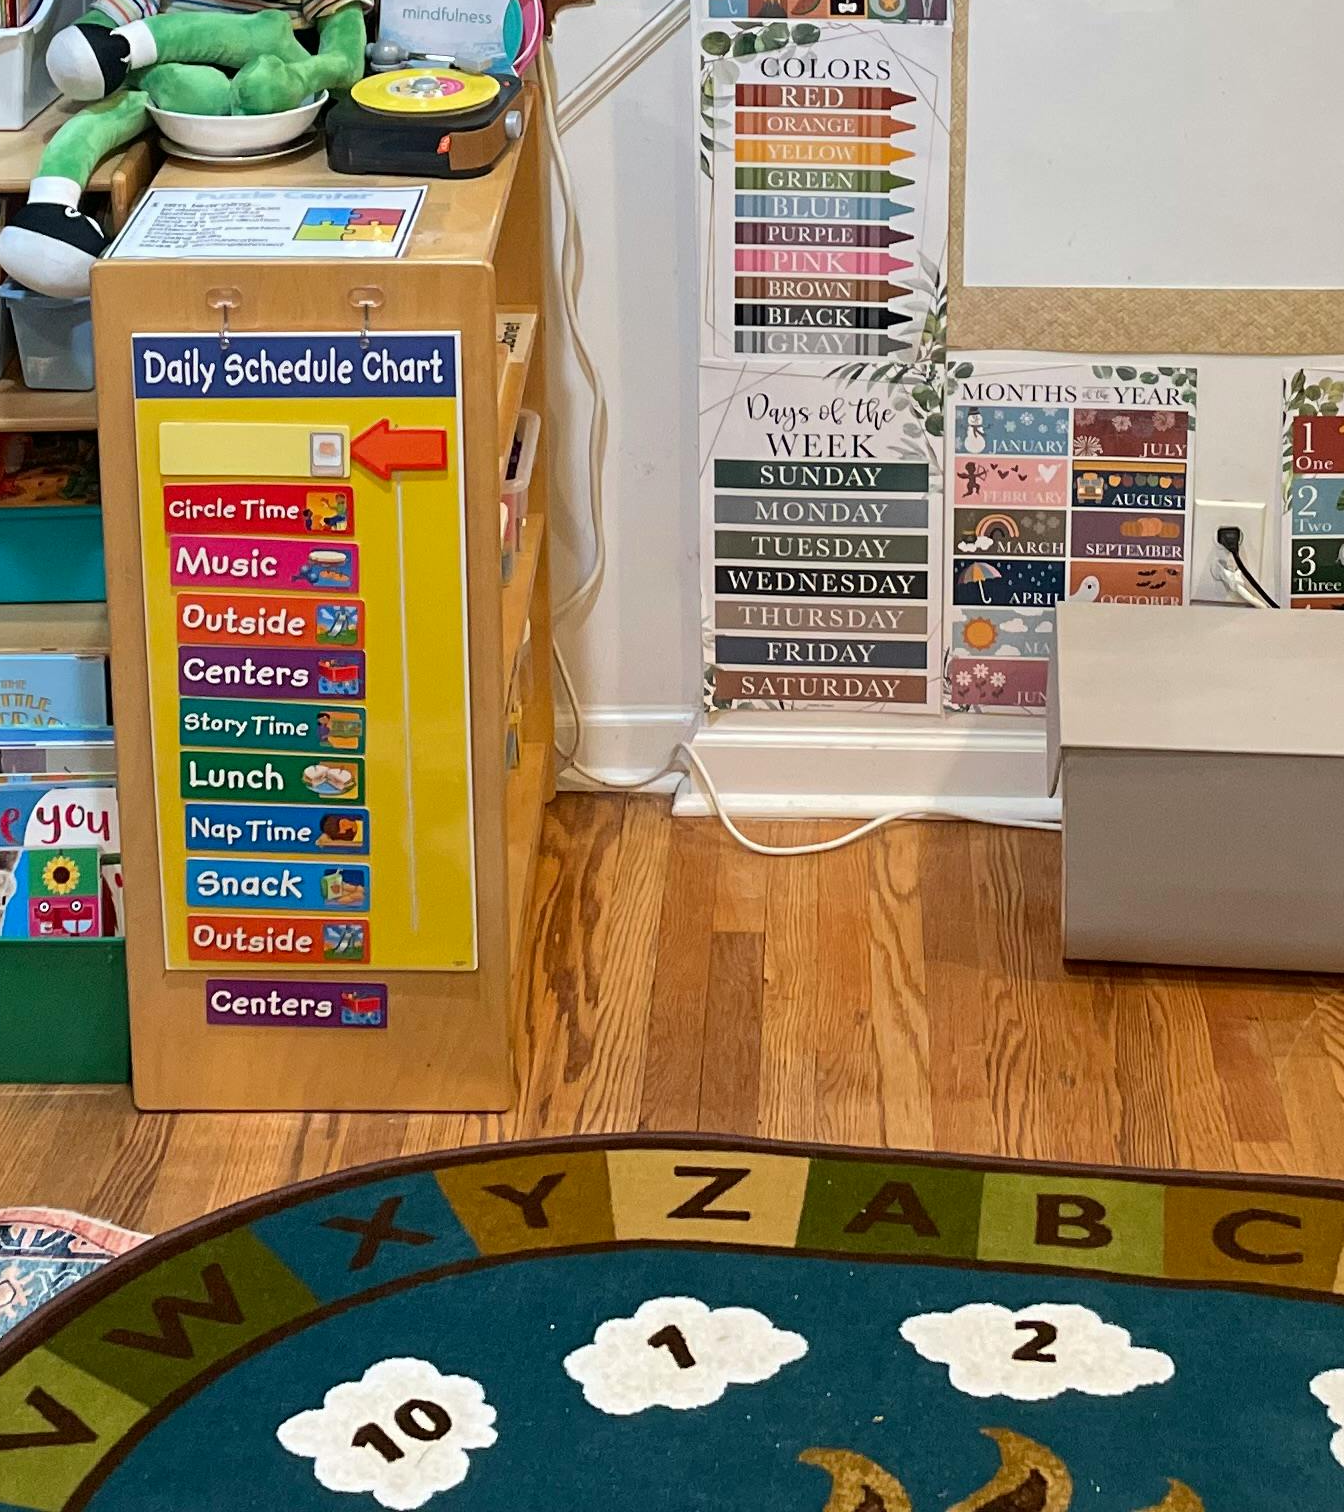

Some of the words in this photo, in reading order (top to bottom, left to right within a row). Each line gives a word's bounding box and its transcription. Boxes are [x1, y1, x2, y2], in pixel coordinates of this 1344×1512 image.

[403, 7, 492, 25] mindfulness
[760, 57, 891, 80] COLORS
[780, 86, 844, 107] RED
[767, 116, 855, 133] ORANGE
[767, 144, 856, 161] YELLOW
[767, 171, 854, 188] GREEN
[772, 197, 850, 217] BLUE
[768, 226, 853, 243] PURPLE
[772, 252, 846, 273] PINK
[768, 281, 852, 299] BROWN
[768, 308, 852, 327] BLACK
[768, 335, 852, 354] GRAY
[143, 348, 216, 394] Daily
[224, 350, 353, 386] Schedule
[362, 348, 443, 384] Chart
[962, 383, 1077, 404] MONTHS
[1114, 387, 1183, 405] YEAR
[747, 393, 808, 431] Days
[819, 398, 842, 424] of
[849, 398, 897, 430] the
[766, 433, 877, 458] WEEK
[989, 439, 1067, 455] JANUARY
[1140, 443, 1188, 458] JULY
[760, 465, 882, 487] SUNDAY
[168, 497, 235, 520] Circle
[240, 499, 299, 521] Time
[755, 501, 889, 523] MONDAY
[1111, 494, 1186, 507] AUGUST
[752, 536, 892, 558] TUESDAY
[997, 542, 1065, 554] MARCH
[1086, 543, 1183, 558] SEPTEMBER
[175, 547, 277, 578] Music
[727, 570, 916, 595] WEDNESDAY
[182, 604, 305, 636] Outside
[738, 606, 904, 629] THURSDAY
[767, 642, 876, 664] FRIDAY
[182, 658, 309, 688] Centers
[741, 676, 901, 698] SATURDAY
[184, 713, 248, 738] Story
[251, 715, 309, 737] Time
[188, 760, 285, 792] Lunch
[36, 803, 110, 844] you
[191, 817, 242, 845] Nap
[246, 821, 312, 842] Time
[196, 870, 303, 899] Snack
[192, 924, 313, 953] Outside
[210, 990, 333, 1018] Centers
[482, 1172, 568, 1229] Y
[664, 1164, 750, 1223] Z
[842, 1179, 941, 1239] A
[319, 1195, 435, 1270] X
[1033, 1193, 1114, 1251] B
[1211, 1207, 1307, 1267] C
[106, 1262, 248, 1358] W
[646, 1324, 697, 1370] 1
[1010, 1319, 1061, 1365] 2
[350, 1398, 453, 1465] 10
